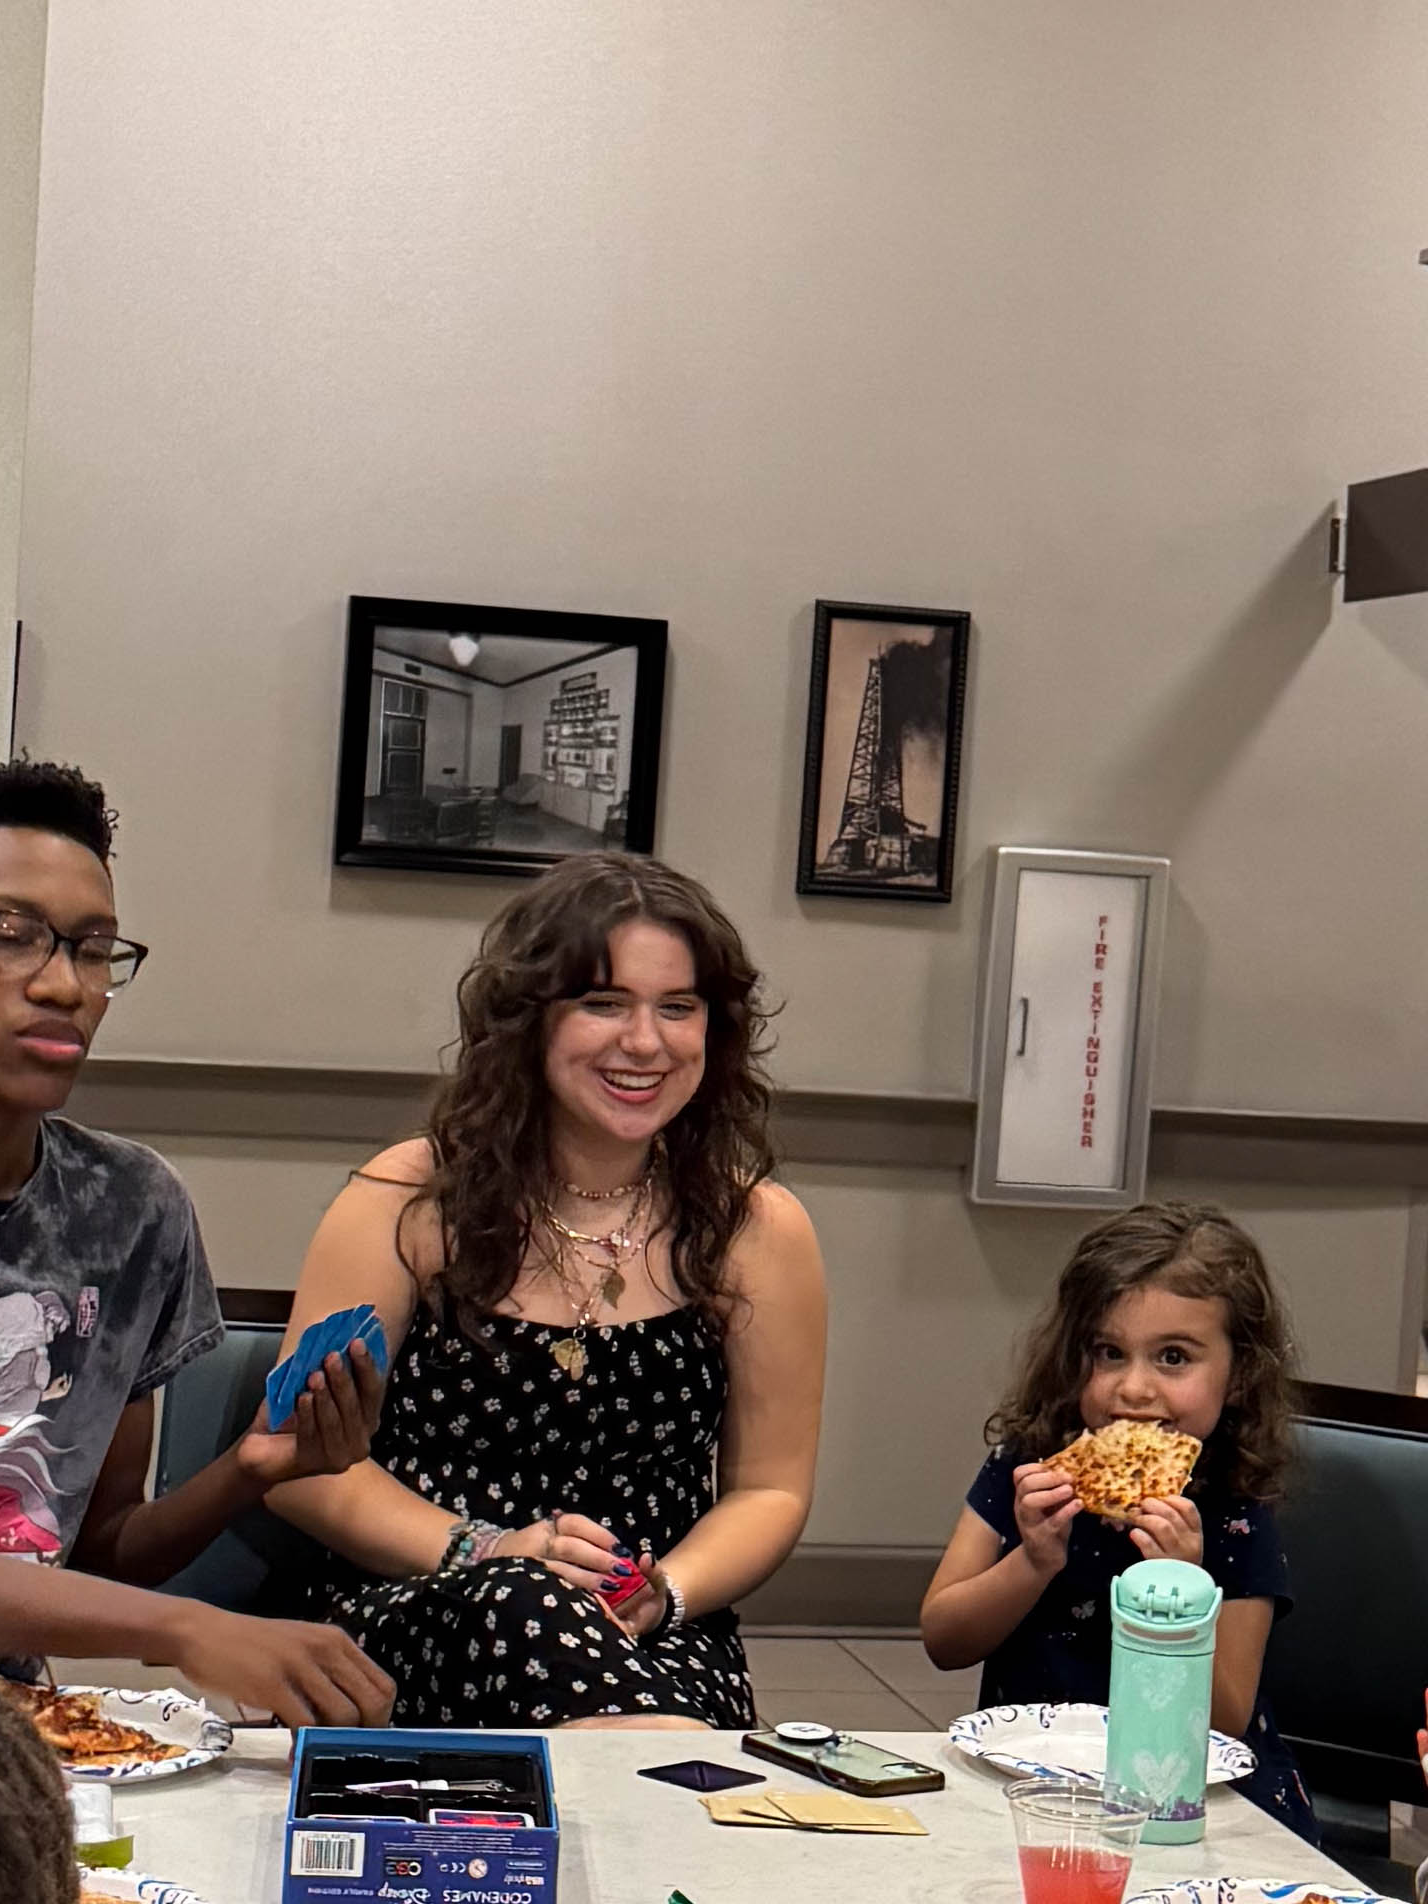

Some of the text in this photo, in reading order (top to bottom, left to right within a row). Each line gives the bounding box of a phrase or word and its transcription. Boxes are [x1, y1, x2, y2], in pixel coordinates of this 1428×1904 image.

[1081, 915, 1108, 1148] FIRE EXTINGUISHER
[443, 1889, 532, 1904] CODENAMES
